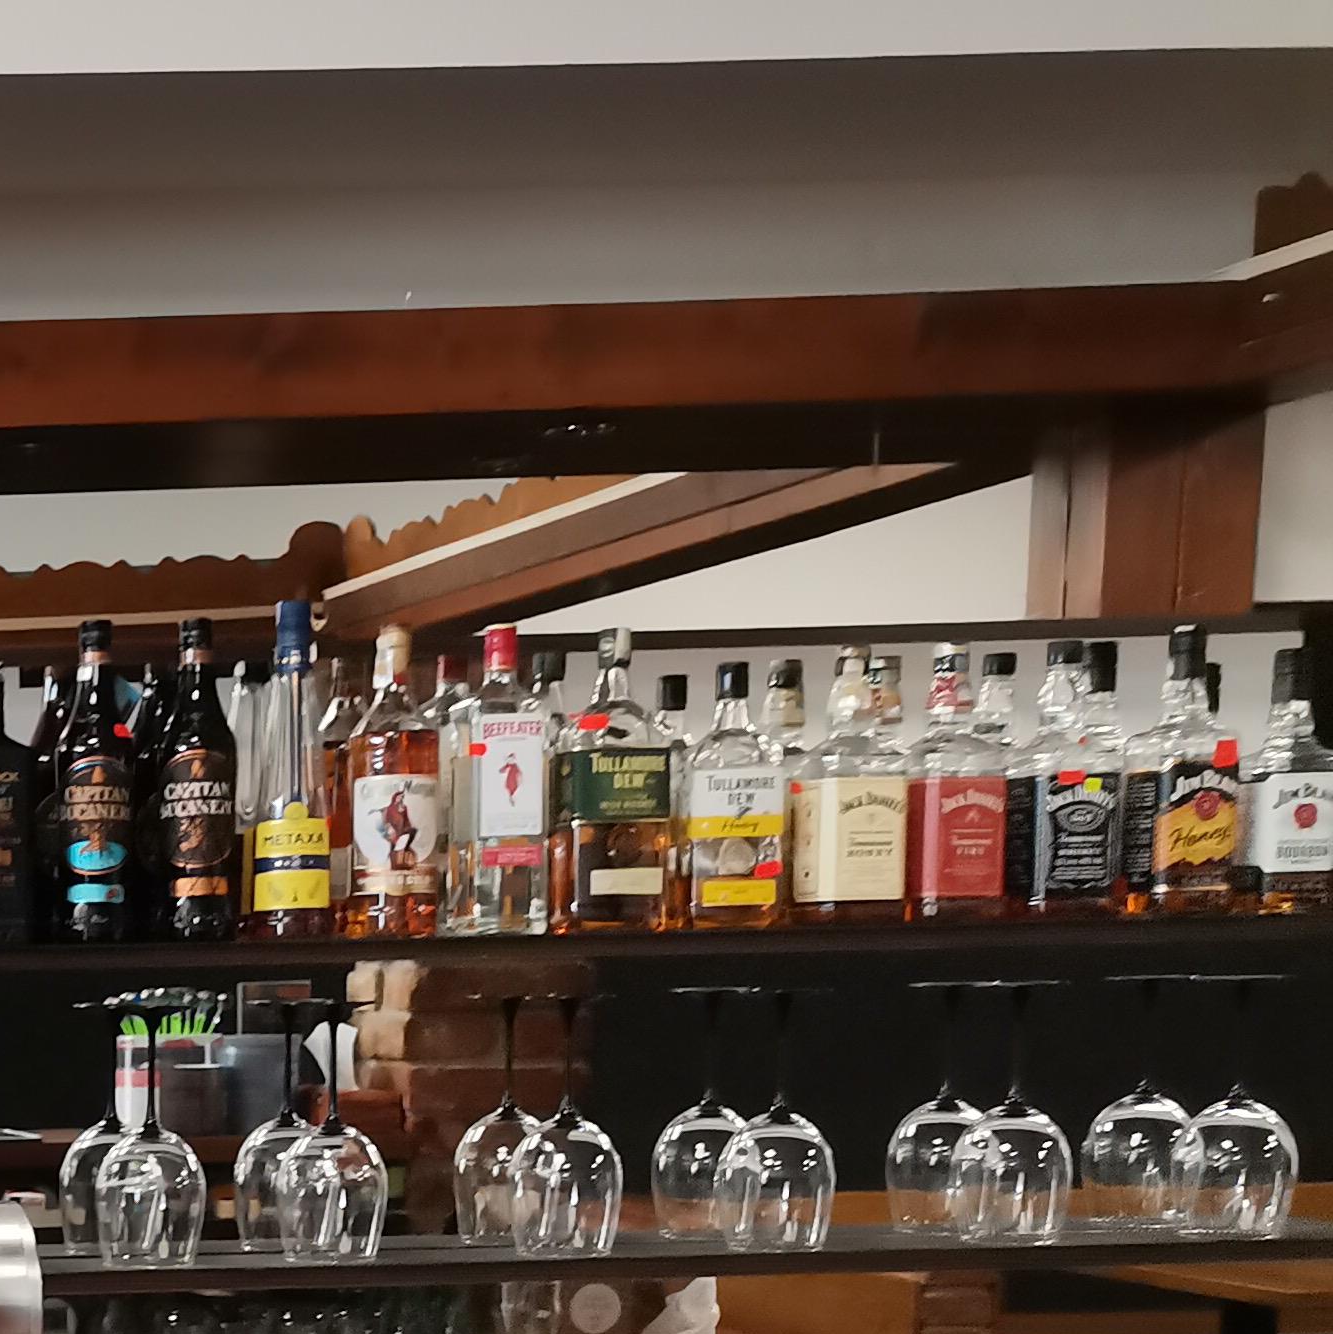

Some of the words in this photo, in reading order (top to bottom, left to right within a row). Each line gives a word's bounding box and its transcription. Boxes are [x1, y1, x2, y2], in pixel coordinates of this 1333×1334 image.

[483, 719, 544, 740] BEEFEATER
[727, 791, 756, 806] DEW
[262, 831, 325, 848] METAXA
